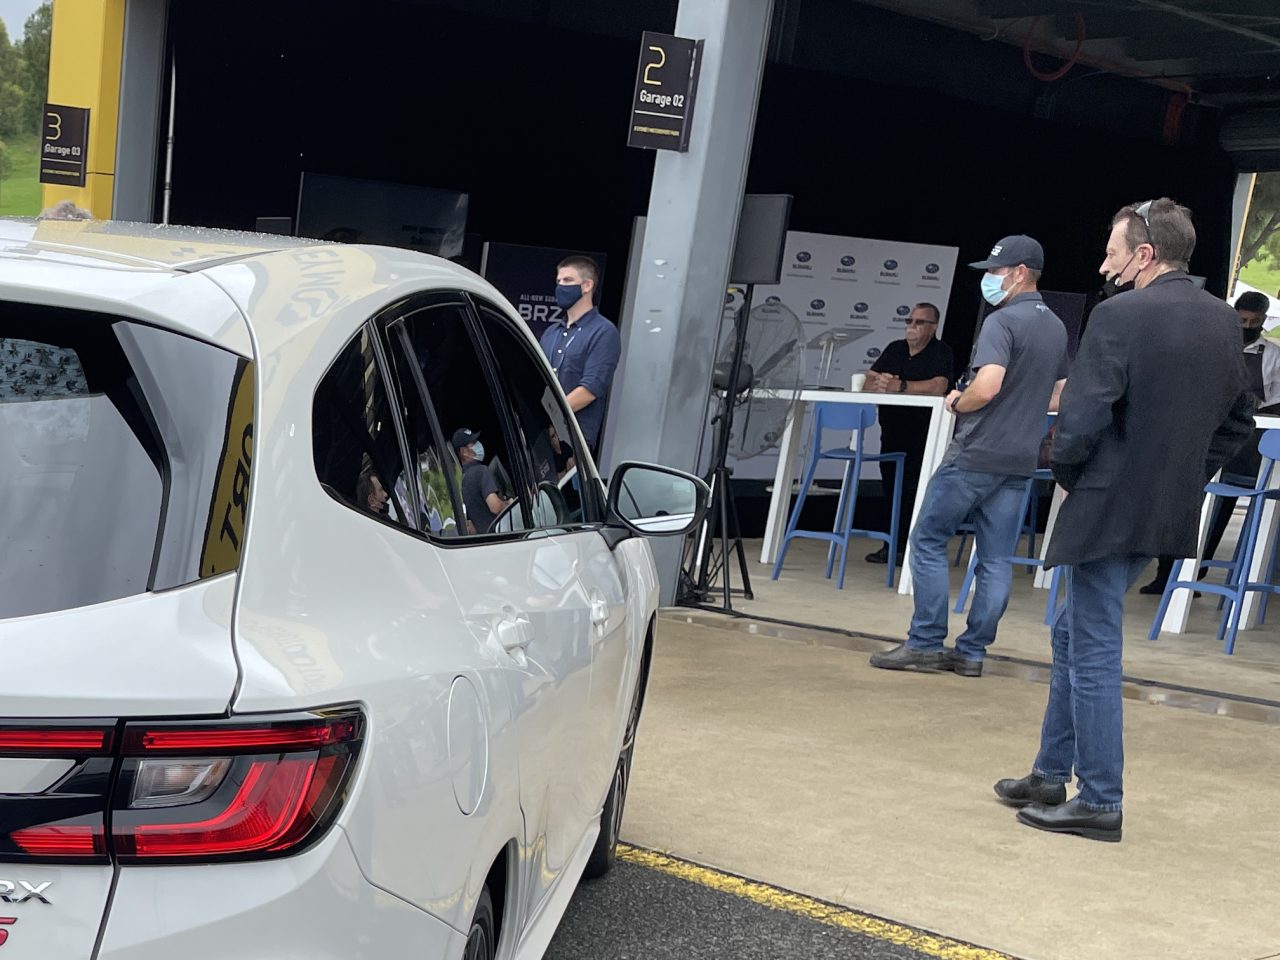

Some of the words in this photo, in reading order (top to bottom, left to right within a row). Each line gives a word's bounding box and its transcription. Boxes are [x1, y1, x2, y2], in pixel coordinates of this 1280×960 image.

[643, 45, 666, 86] 2
[640, 89, 672, 108] Garage
[672, 94, 685, 107] 02
[45, 112, 62, 140] 3
[44, 143, 71, 157] Garage
[518, 303, 563, 323] BRZ
